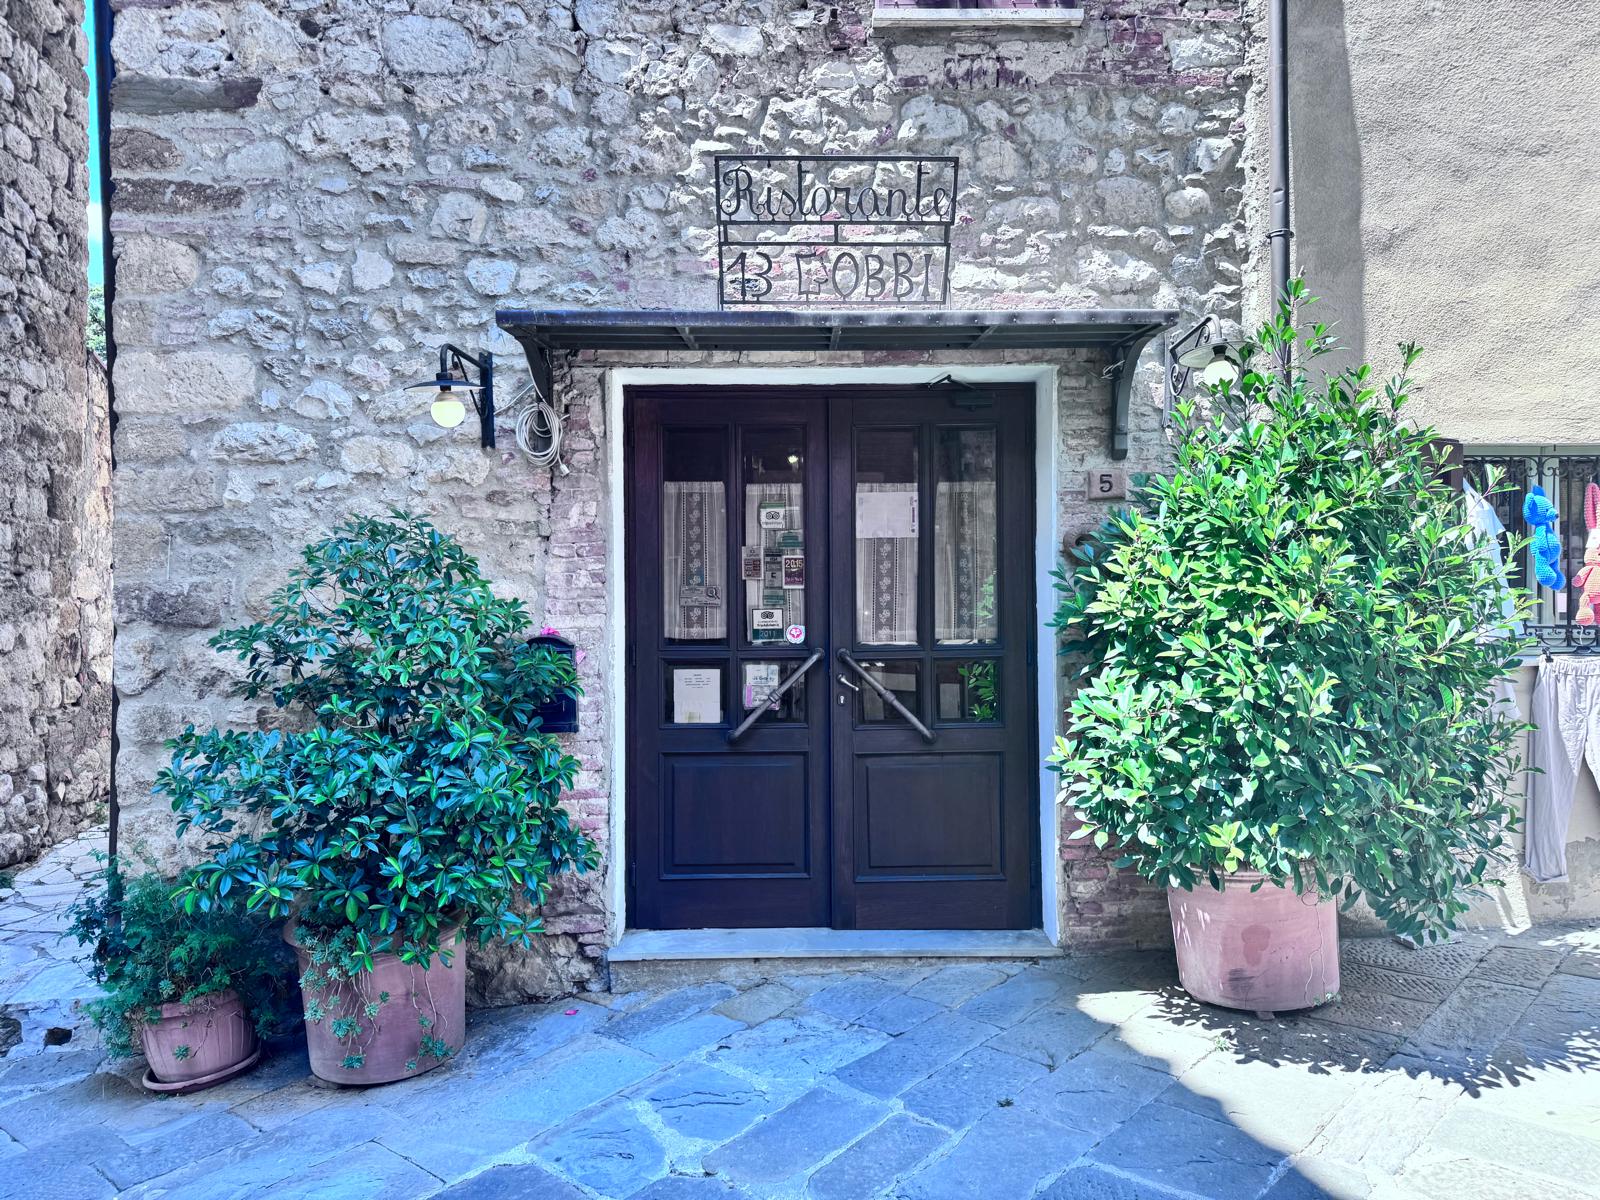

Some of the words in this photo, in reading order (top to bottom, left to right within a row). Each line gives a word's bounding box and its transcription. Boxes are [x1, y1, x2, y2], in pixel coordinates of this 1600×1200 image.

[720, 161, 954, 218] Ristorante
[726, 252, 773, 298] 13
[795, 252, 933, 298] GOBBI
[1099, 473, 1114, 493] 5
[785, 559, 803, 568] 2015
